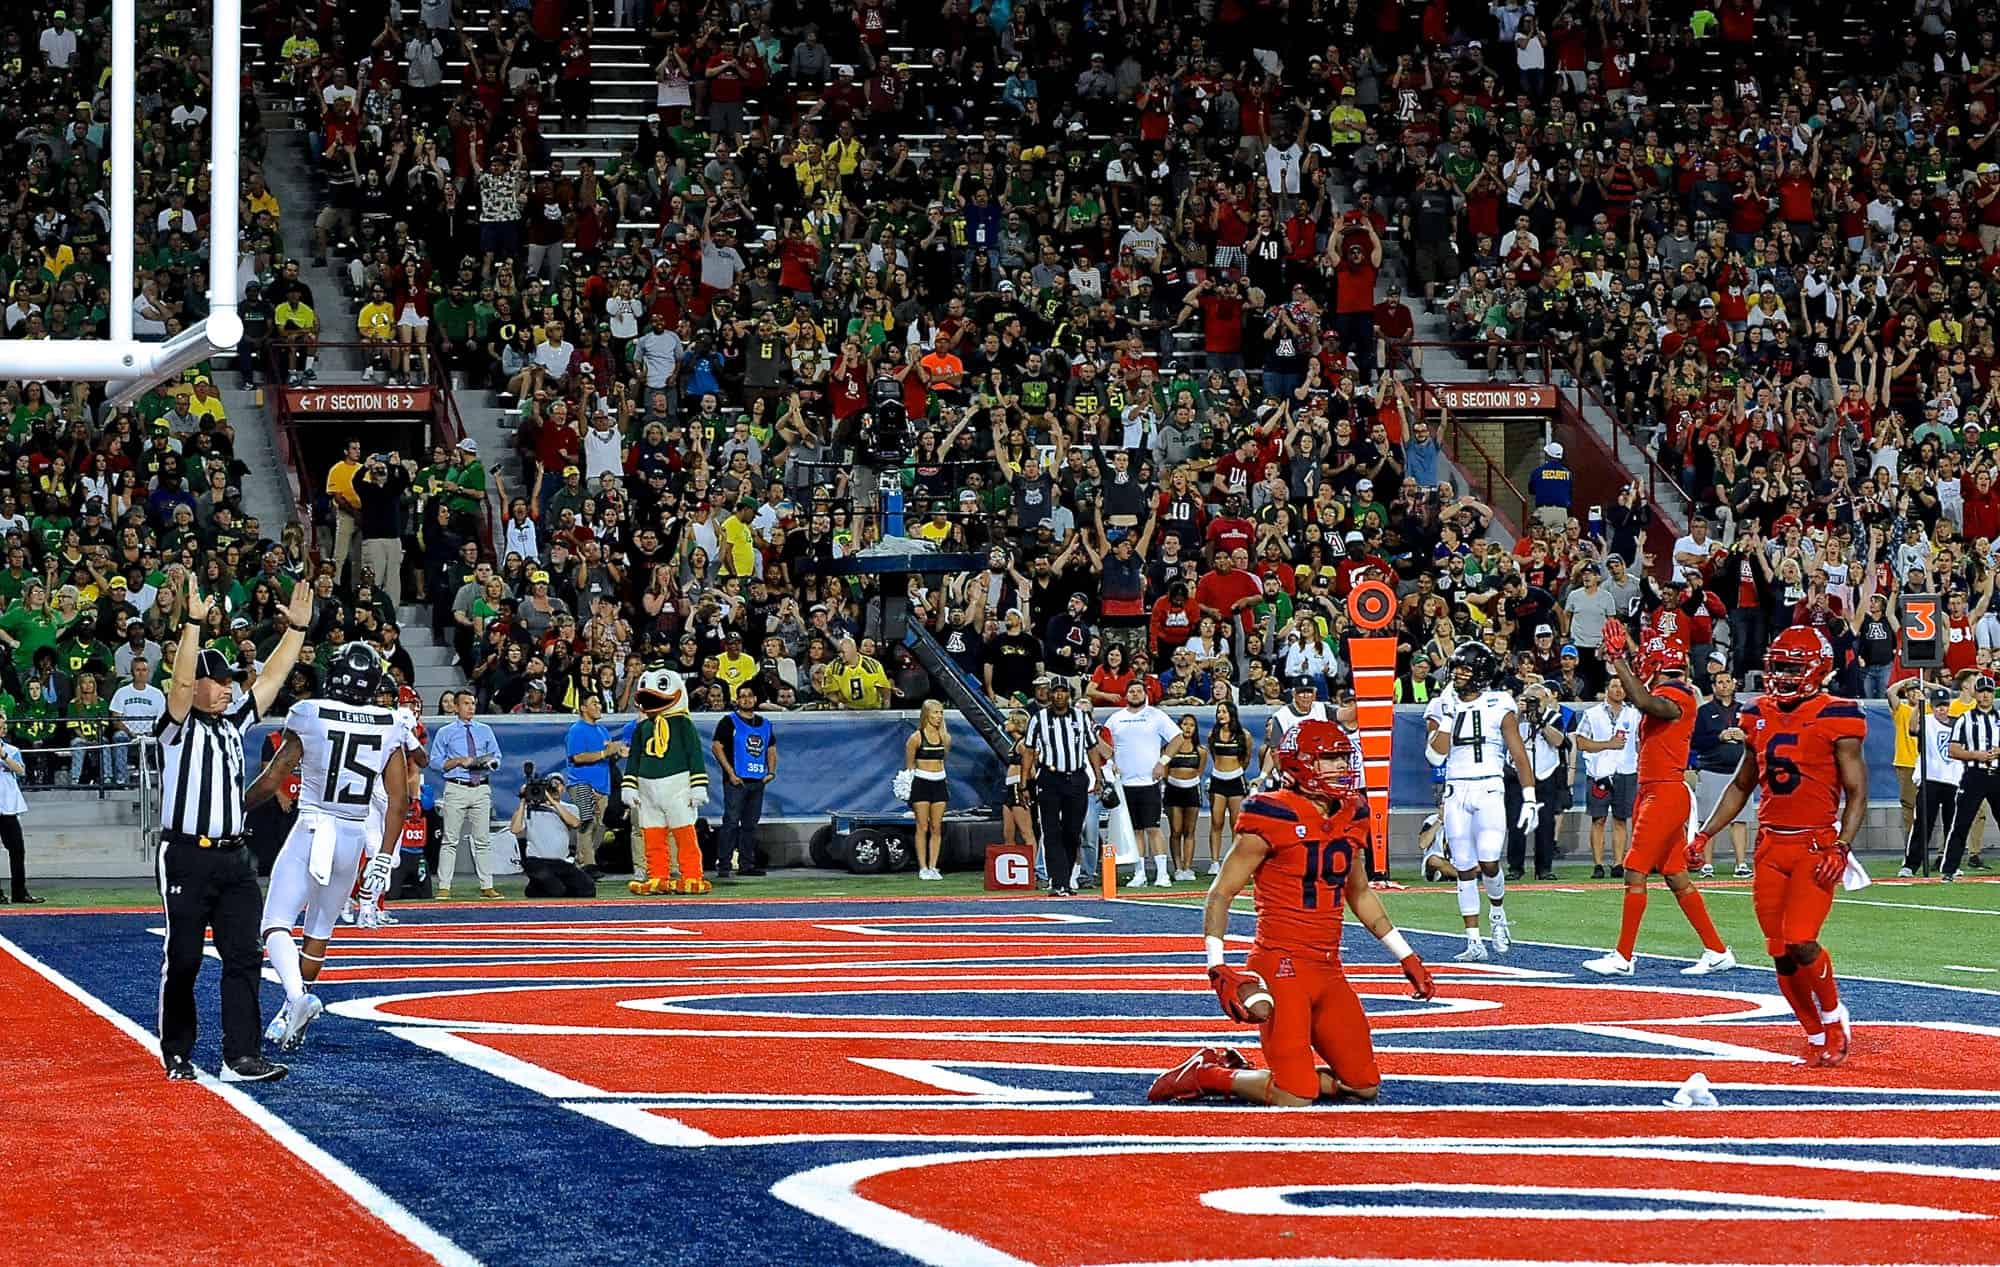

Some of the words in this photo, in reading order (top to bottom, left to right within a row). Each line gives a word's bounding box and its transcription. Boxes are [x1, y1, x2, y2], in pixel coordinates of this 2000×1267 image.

[1259, 240, 1278, 260] 40
[1275, 338, 1296, 357] A
[315, 395, 326, 410] 17
[330, 394, 382, 410] SECTION
[386, 394, 399, 409] 18
[1445, 392, 1458, 407] 18
[1462, 391, 1510, 407] SECTION
[1514, 391, 1526, 407] 19
[1230, 467, 1247, 485] UA
[1172, 502, 1191, 520] 10
[1906, 602, 1936, 640] 3
[1866, 622, 1888, 640] A
[124, 696, 153, 706] OREGON
[339, 711, 376, 724] LENOIR
[1453, 710, 1486, 762] 4
[324, 730, 382, 805] 15
[747, 762, 764, 773] 353
[1766, 733, 1801, 795] 6
[994, 852, 1029, 886] G
[1303, 839, 1353, 909] 19
